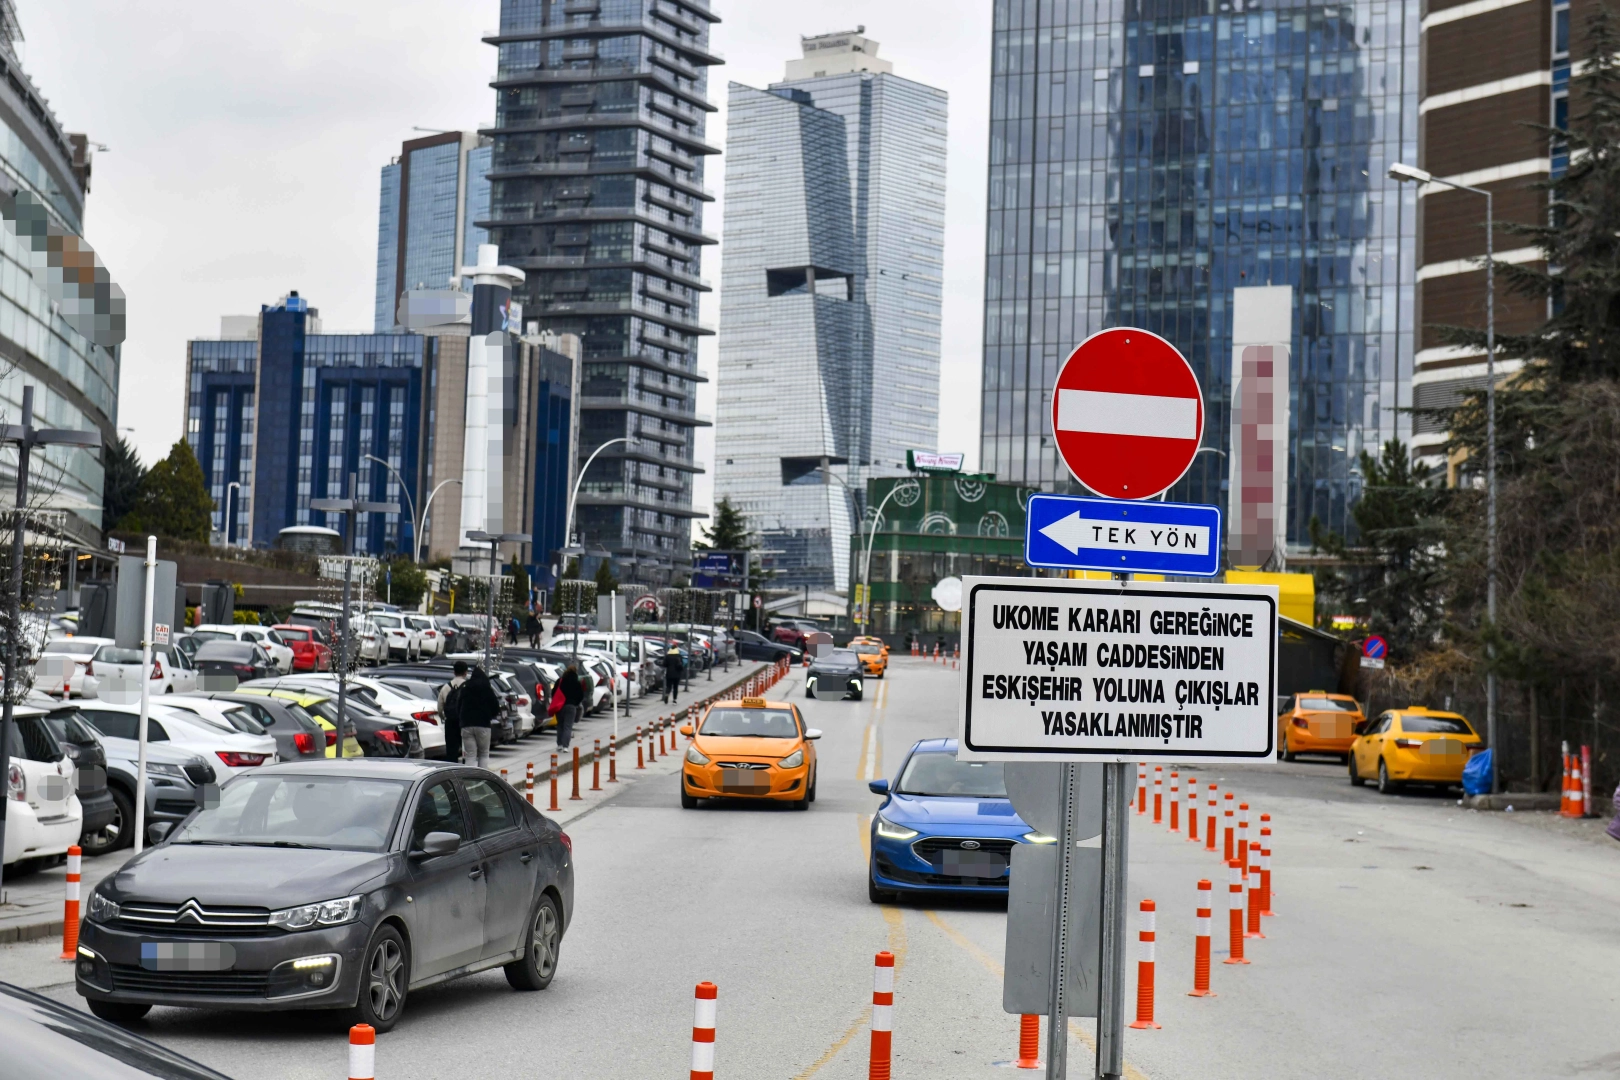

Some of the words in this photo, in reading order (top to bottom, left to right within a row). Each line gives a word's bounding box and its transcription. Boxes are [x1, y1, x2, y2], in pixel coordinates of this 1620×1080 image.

[1092, 526, 1136, 545] TEK
[1150, 527, 1197, 549] YÖN
[992, 604, 1060, 631] UKOME
[1068, 607, 1141, 634] KARARI
[1022, 640, 1088, 672] YAŞAM
[1092, 677, 1166, 704] YOLUNA
[1174, 679, 1260, 711] ÇIKIŞLAR
[1040, 710, 1204, 745] YASAKLANMIŞTIR
